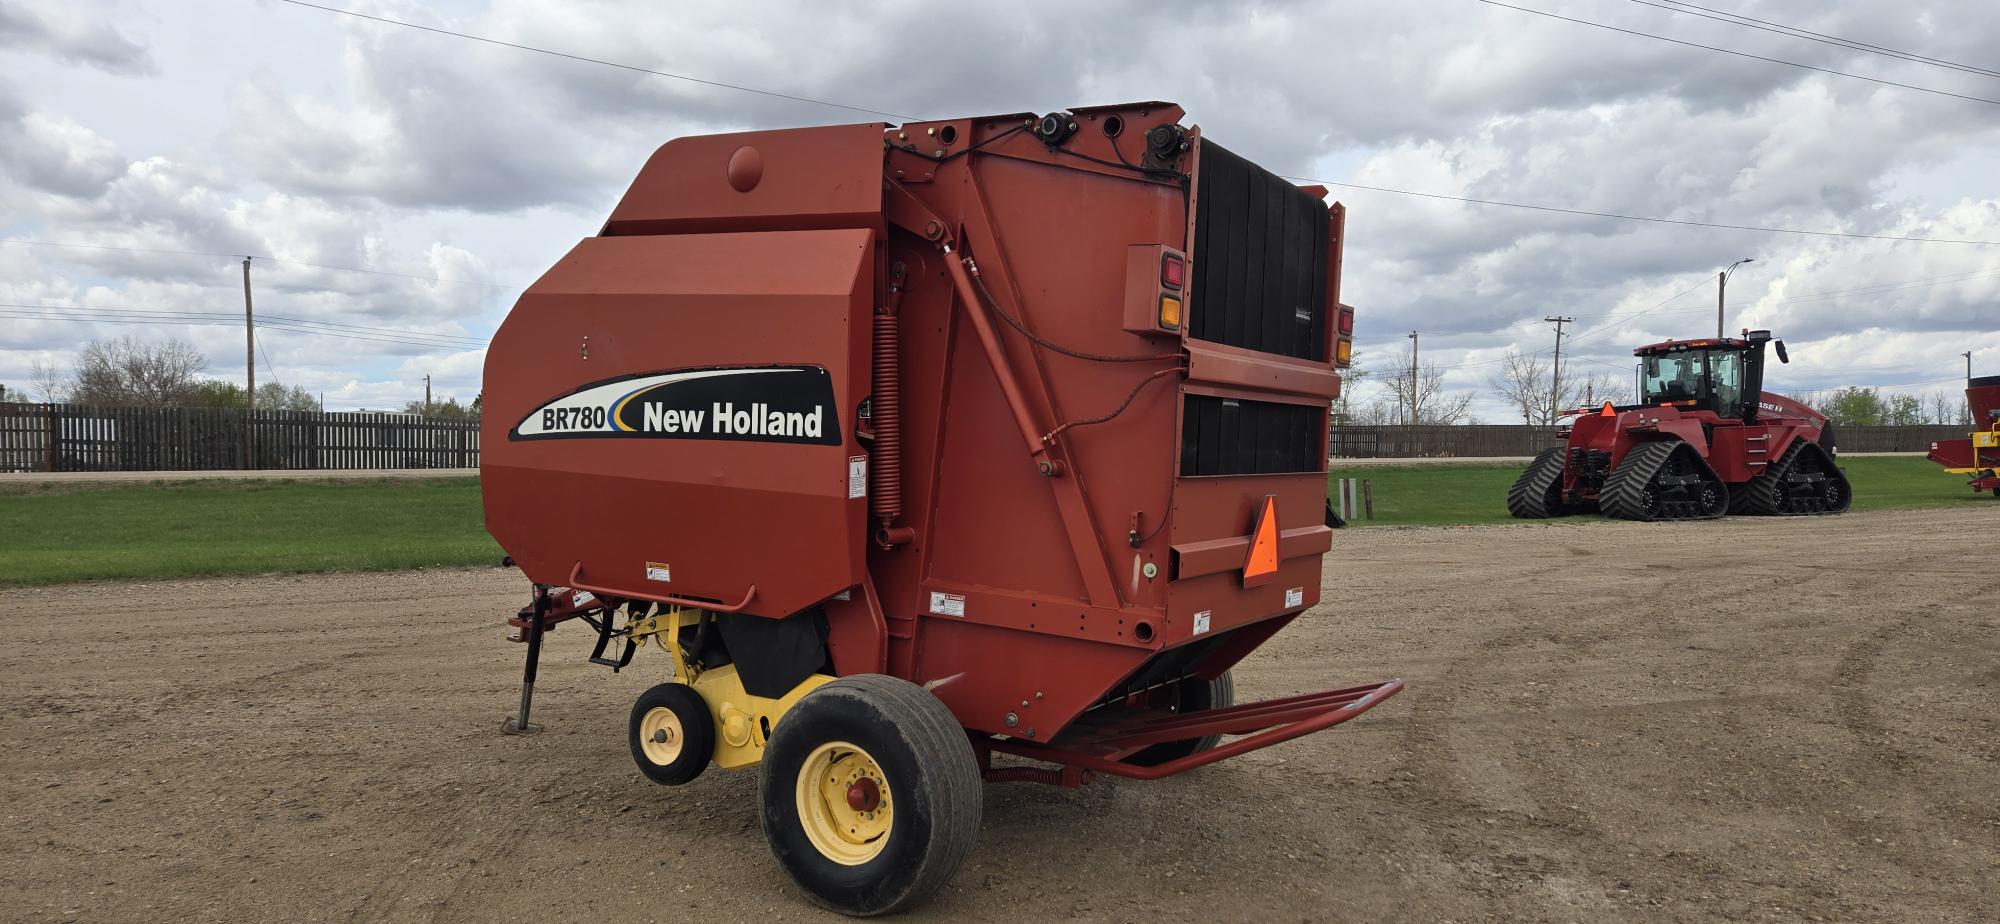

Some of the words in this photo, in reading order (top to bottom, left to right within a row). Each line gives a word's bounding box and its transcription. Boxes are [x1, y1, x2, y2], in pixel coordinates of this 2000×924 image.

[542, 406, 605, 430] BR780
[643, 402, 704, 433] New
[712, 402, 822, 437] Holland
